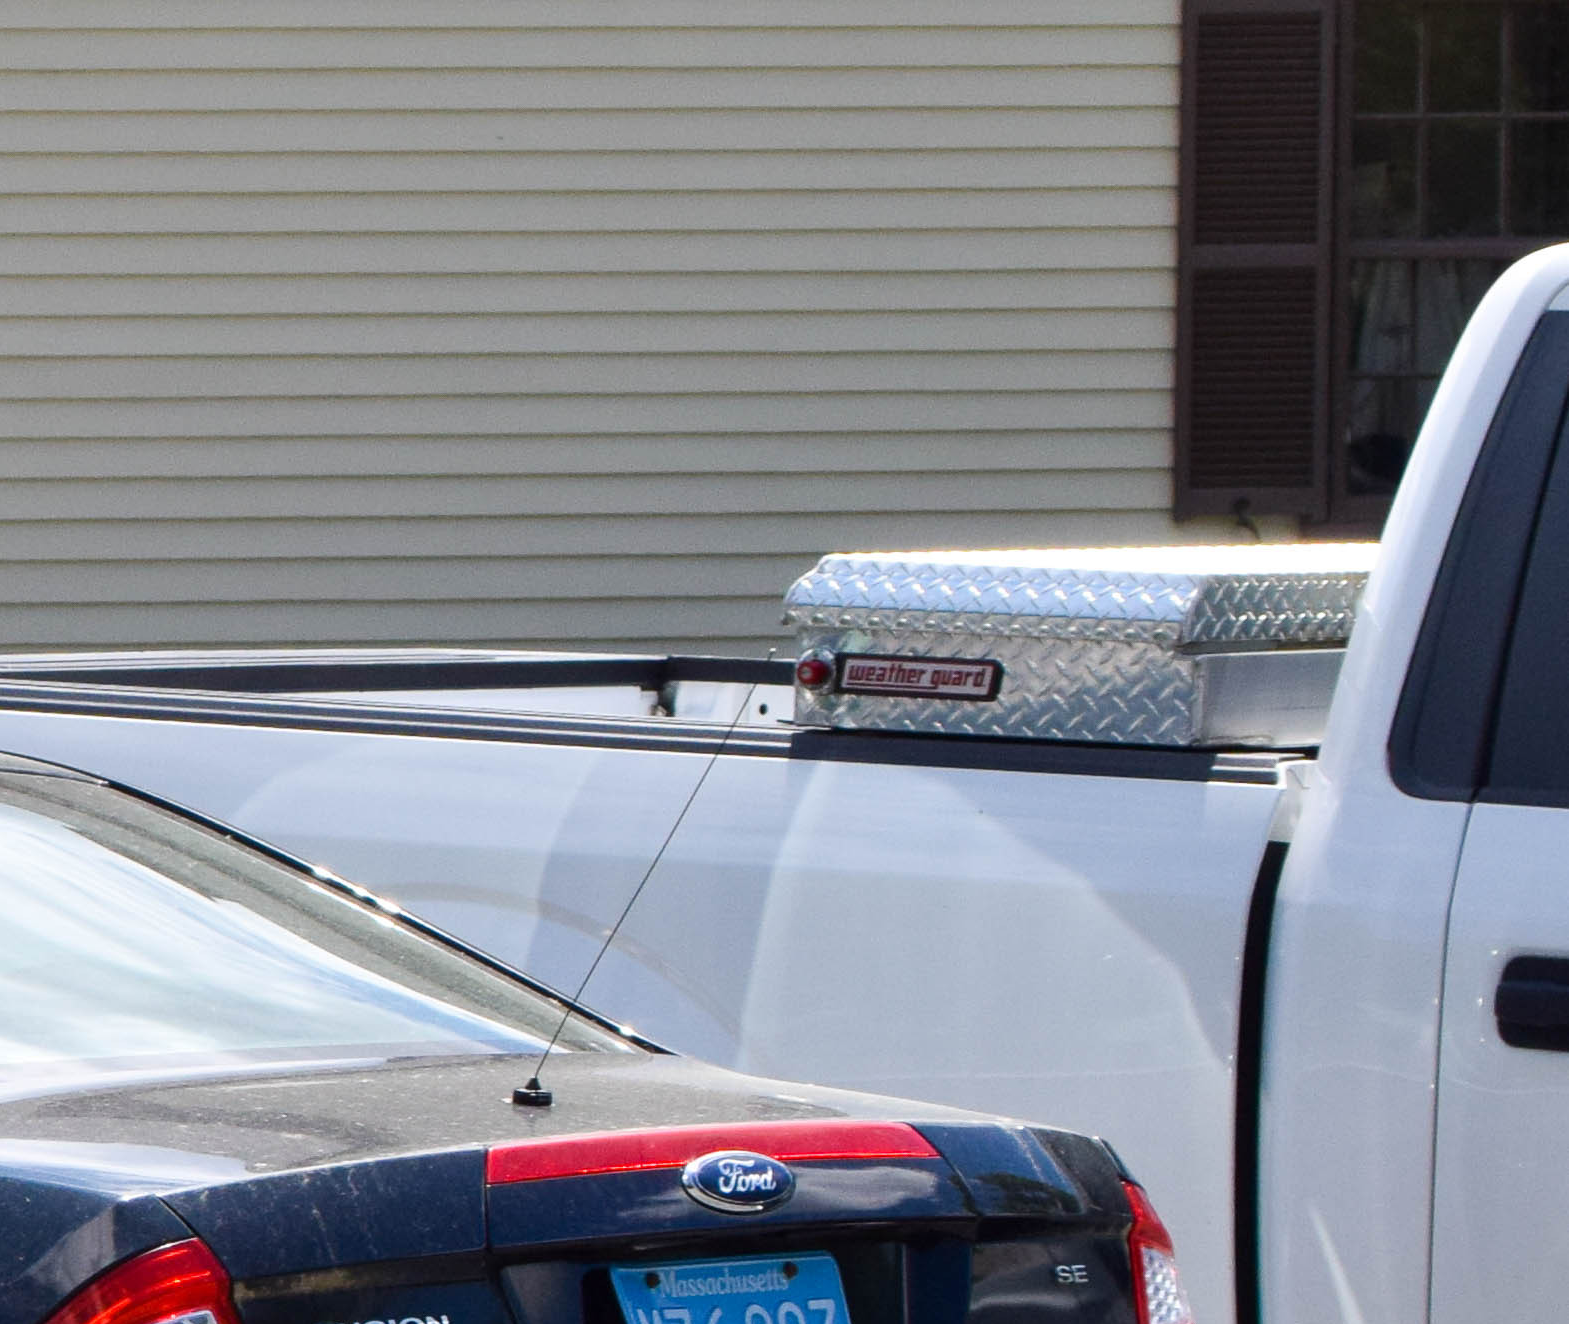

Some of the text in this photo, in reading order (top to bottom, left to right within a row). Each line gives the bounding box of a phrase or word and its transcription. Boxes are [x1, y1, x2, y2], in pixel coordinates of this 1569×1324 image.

[848, 663, 987, 689] weather guard
[718, 1158, 777, 1194] Ford
[662, 1268, 790, 1298] Massachusetts
[1055, 1264, 1090, 1284] SE
